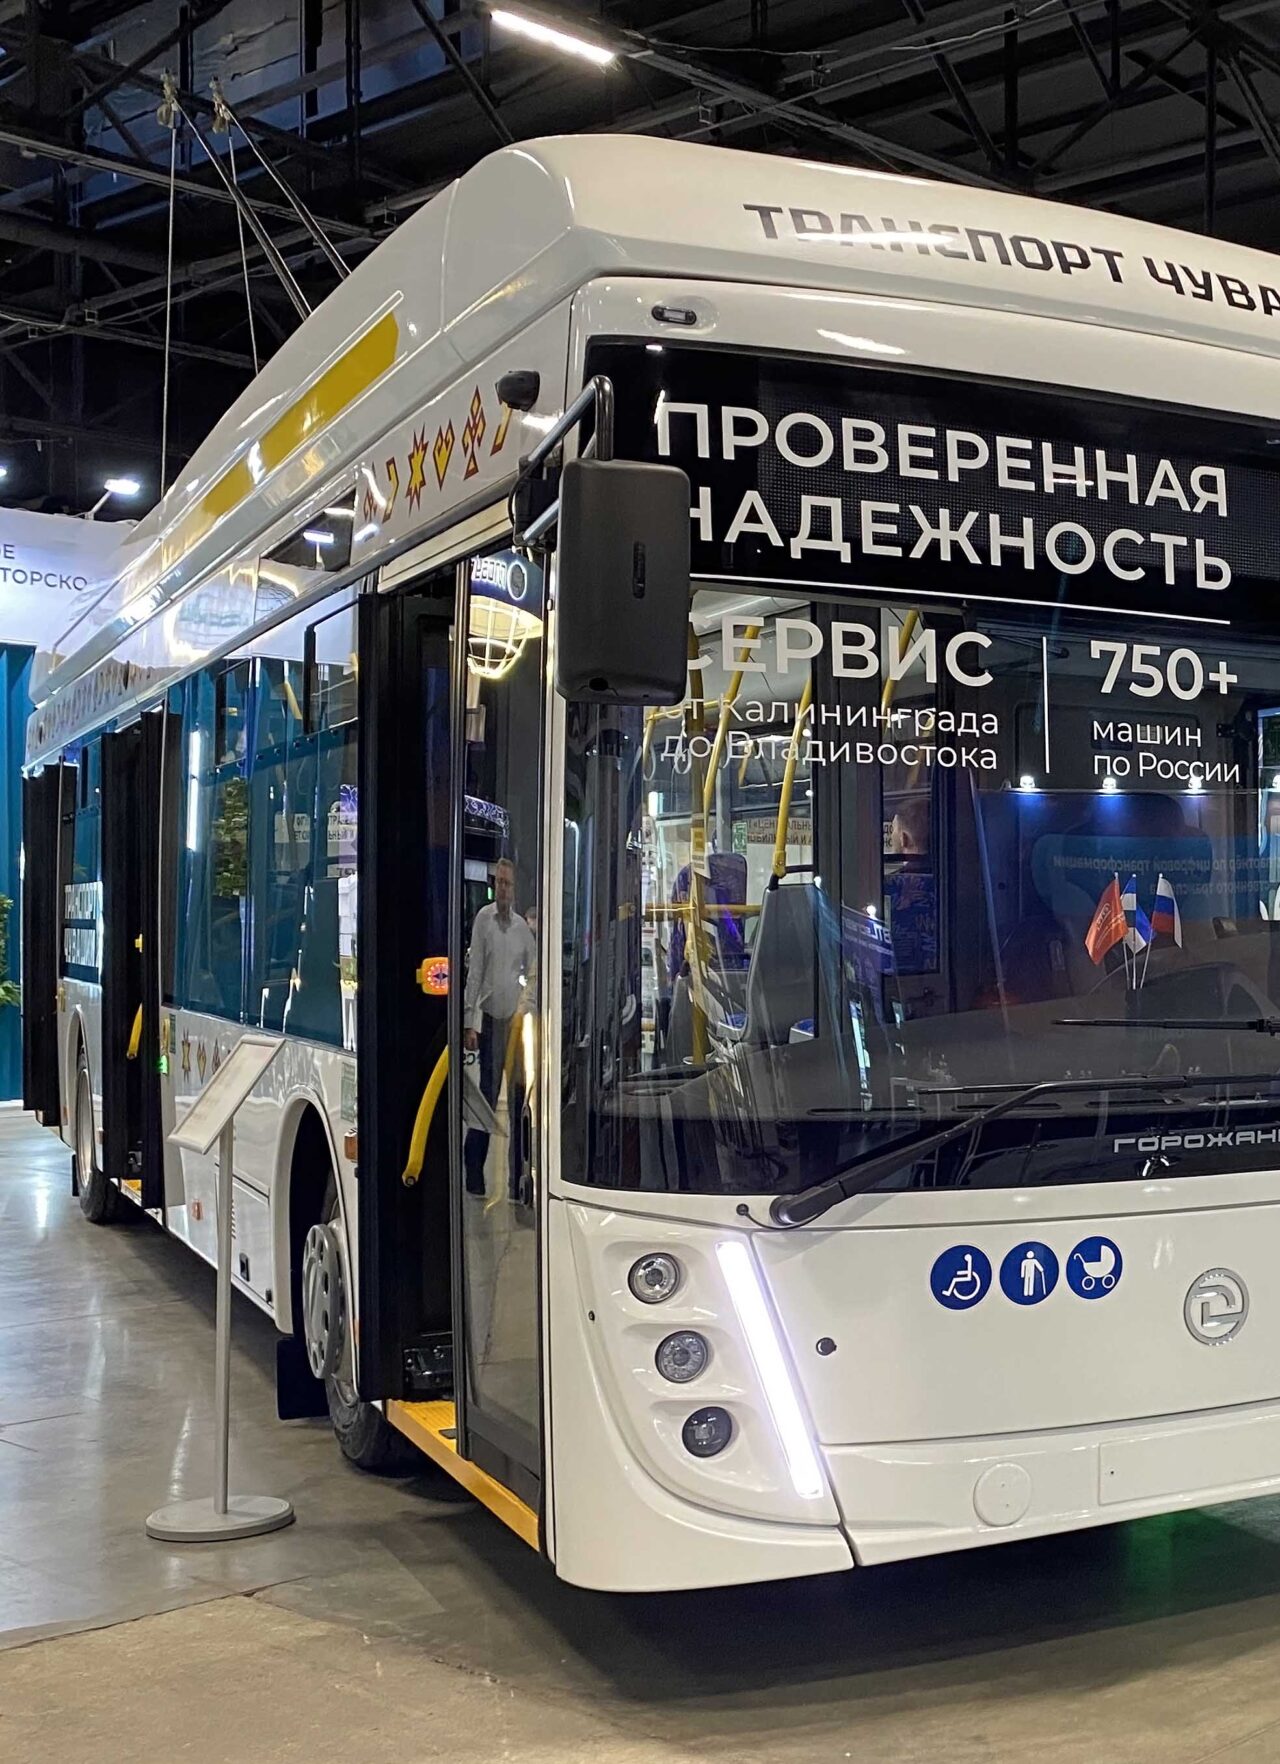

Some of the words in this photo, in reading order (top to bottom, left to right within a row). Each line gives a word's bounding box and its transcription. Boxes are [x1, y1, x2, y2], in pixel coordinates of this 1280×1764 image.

[743, 203, 1123, 284] ТРАНСПОРТ
[656, 402, 1228, 517] ПРОВЕРЕННАЯ
[1090, 640, 1238, 701] 750+
[719, 693, 999, 738] Калининграда
[1093, 720, 1202, 748] машин
[660, 735, 712, 763] до
[728, 731, 998, 770] Владивостока
[1093, 753, 1131, 777] по
[1138, 752, 1240, 784] России
